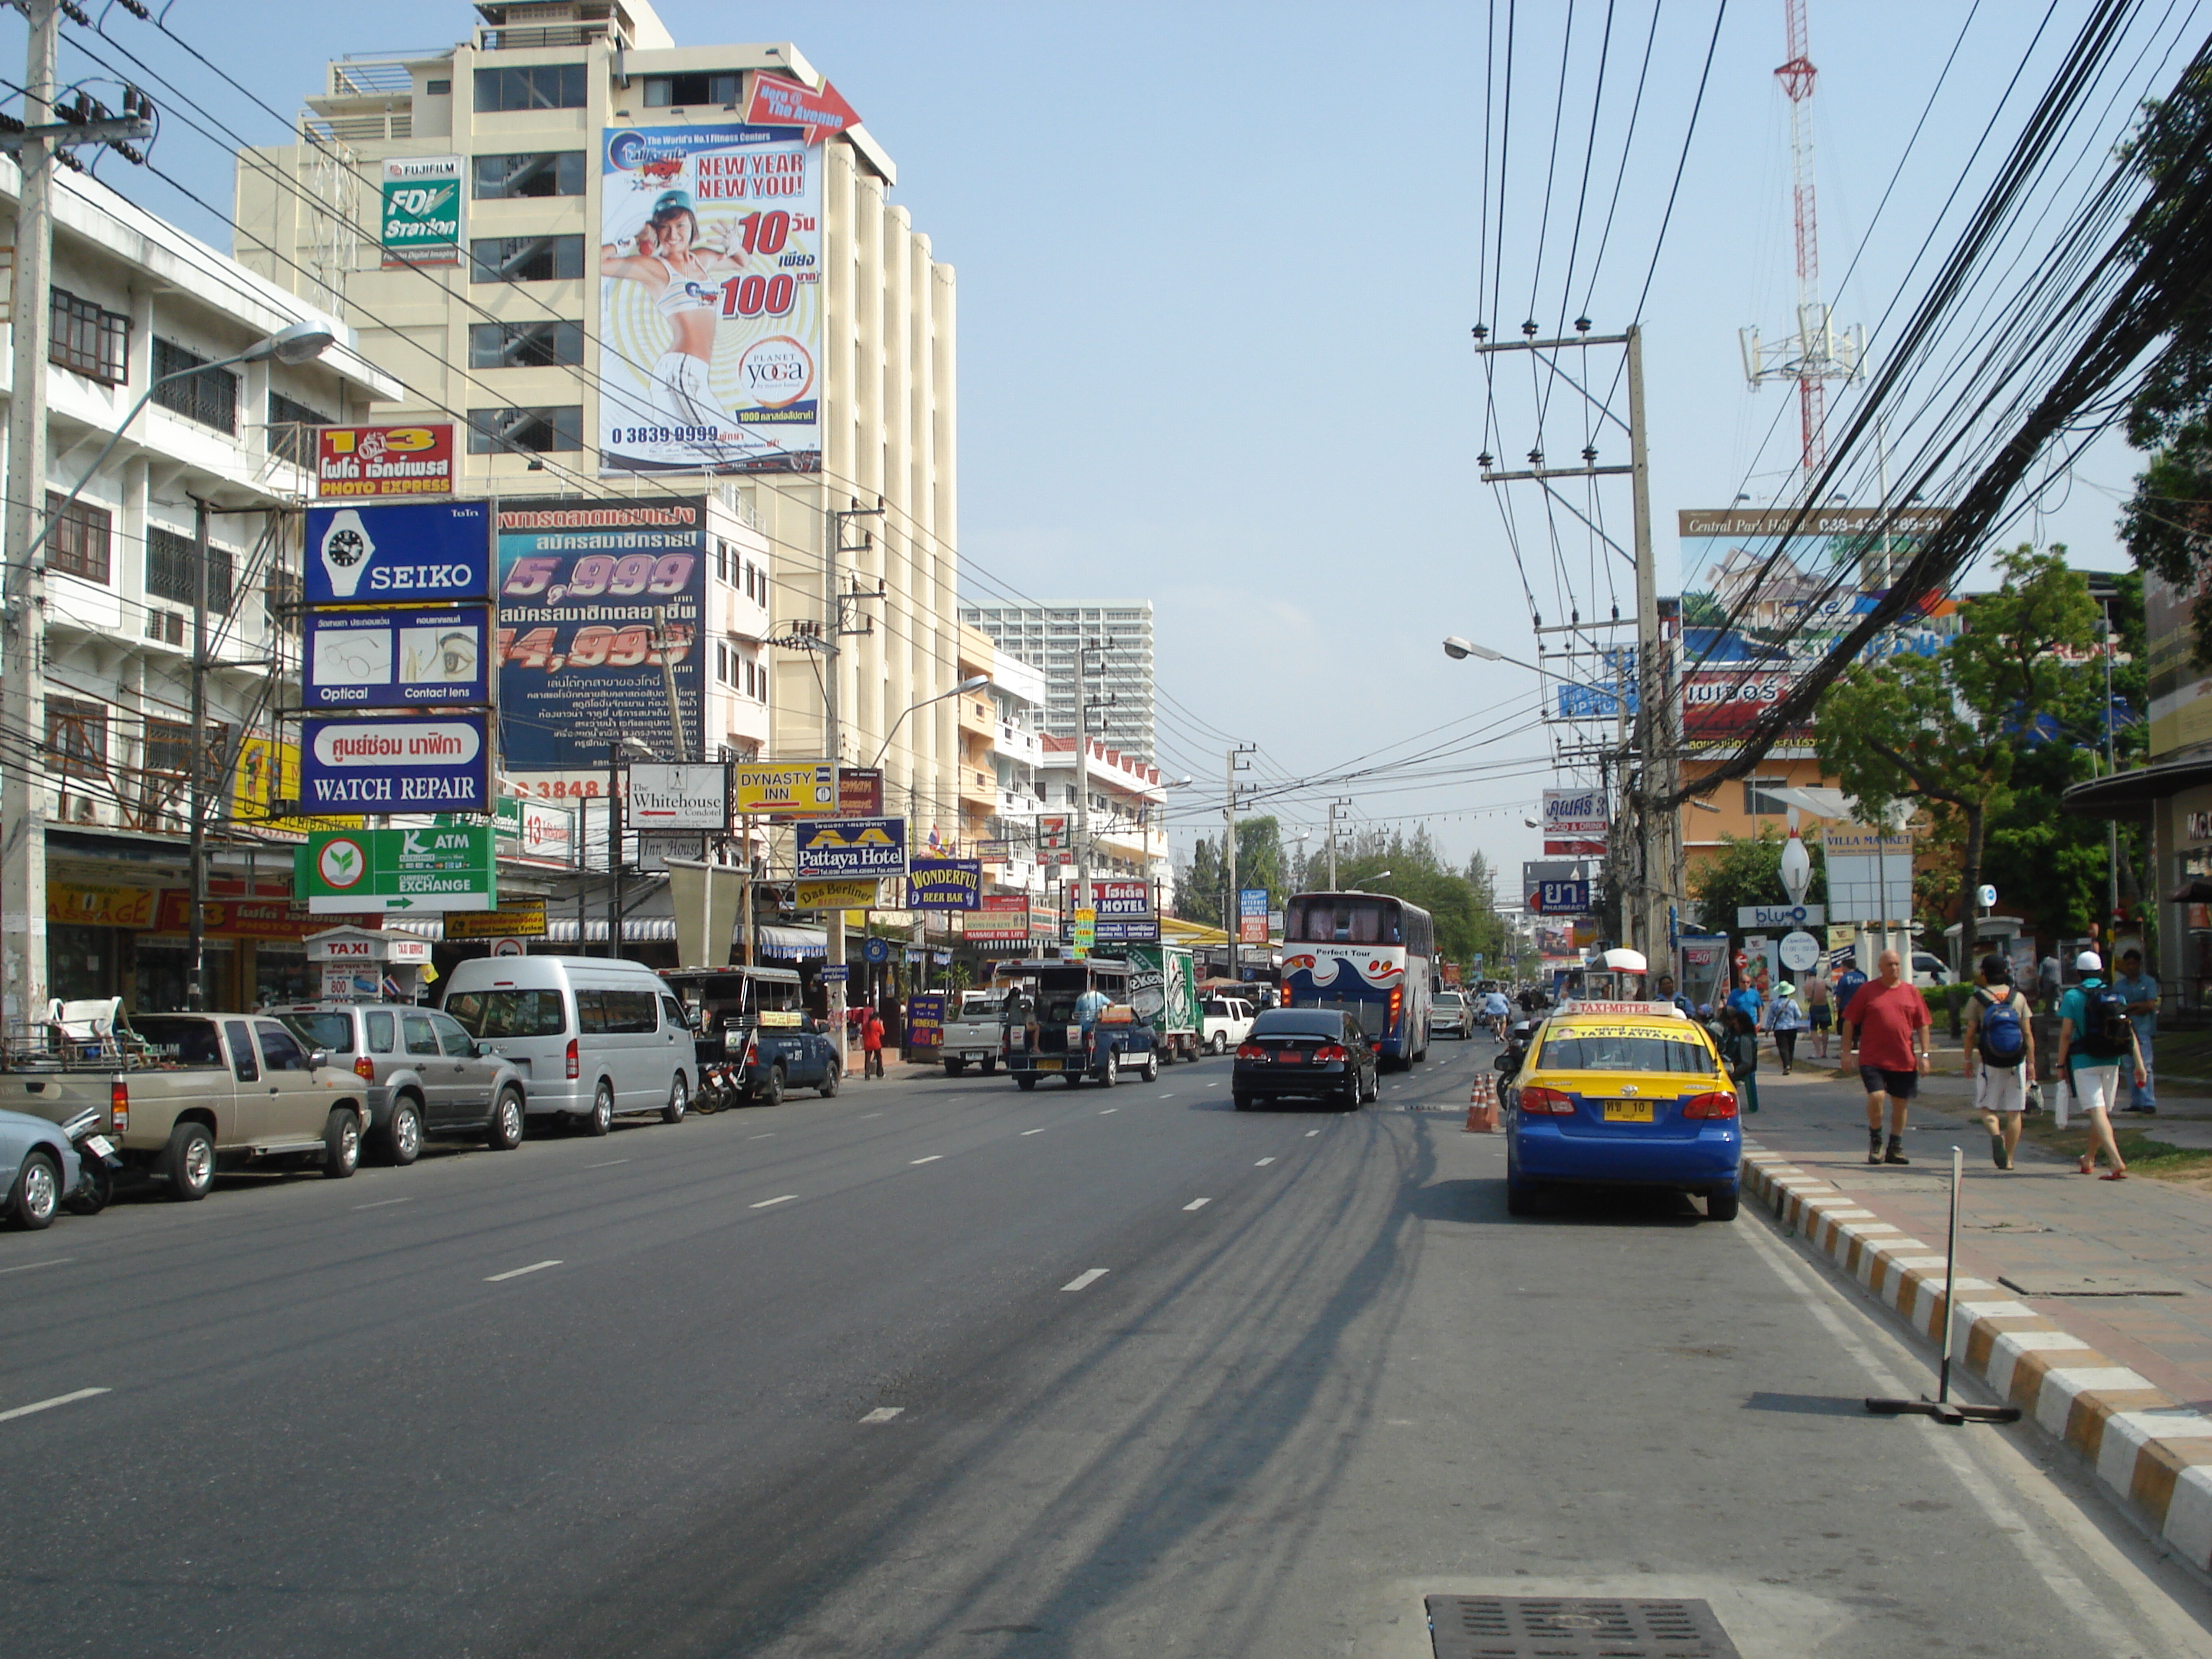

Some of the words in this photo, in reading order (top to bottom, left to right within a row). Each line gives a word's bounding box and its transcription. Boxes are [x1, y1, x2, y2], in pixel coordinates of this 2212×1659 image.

[760, 86, 788, 102] Here
[768, 101, 791, 117] The
[793, 106, 842, 127] Avenue
[648, 136, 661, 145] The
[662, 135, 693, 145] World's
[710, 134, 739, 143] Fitness
[739, 132, 770, 142] Centers
[405, 163, 455, 176] FUJIFILM
[698, 156, 745, 177] NEW
[750, 153, 804, 175] YEAR
[698, 178, 746, 199] NEW
[751, 175, 803, 197] YOU!
[385, 217, 457, 239] Station
[791, 212, 816, 232] วัน
[739, 210, 791, 254] 10
[778, 251, 816, 268] เพียง
[721, 274, 797, 319] 100
[754, 354, 795, 362] PLANET
[739, 411, 760, 422] 1000
[612, 428, 621, 444] 0
[626, 426, 670, 443] 3839
[675, 425, 718, 441] 0999
[366, 455, 449, 478] เอ็กซ์เพรส
[321, 482, 376, 495] PHOTO
[382, 479, 450, 493] EXPRESS
[1689, 519, 1731, 533] Central
[1735, 519, 1762, 532] Park
[370, 564, 472, 590] SEIKO
[502, 553, 696, 606] 5,999
[320, 687, 369, 703] Optical
[404, 687, 447, 698] Contact
[449, 685, 470, 698] lens
[408, 732, 462, 755] นาฬิกา
[742, 773, 811, 786] DYNASTY
[313, 778, 392, 801] WATCH
[400, 776, 476, 800] REPAIR
[765, 788, 789, 799] INN
[634, 792, 721, 808] Whitehouse
[1597, 796, 1606, 817] 3
[685, 808, 721, 817] Condotel
[528, 815, 541, 845] 13
[403, 830, 431, 855] K
[434, 835, 469, 849] ATM
[644, 840, 662, 855] Inn
[667, 840, 699, 858] House
[1828, 837, 1859, 845] VILLA
[799, 850, 858, 868] Pattaya
[861, 848, 903, 865] Hotel
[1048, 855, 1058, 863] 24
[399, 879, 471, 892] EXCHANGE
[911, 869, 978, 891] WONDERFUL
[800, 887, 824, 904] Das
[827, 884, 873, 902] Berliner
[923, 892, 945, 902] BEER
[947, 892, 963, 902] BAR
[1545, 883, 1578, 903] ยา
[47, 892, 149, 924] ASSAGE
[1102, 900, 1145, 912] HOTEL
[235, 922, 292, 931] PHOTO
[328, 943, 369, 954] TAXI
[398, 944, 408, 954] TAXI
[409, 944, 423, 954] SERVICE
[1794, 955, 1800, 963] 3
[331, 981, 346, 993] 800
[1129, 973, 1164, 990] eken
[912, 1018, 938, 1028] HEINEKEN
[912, 1030, 931, 1044] 45
[1619, 1031, 1680, 1040] PATTAYA
[1634, 1102, 1645, 1112] 10
